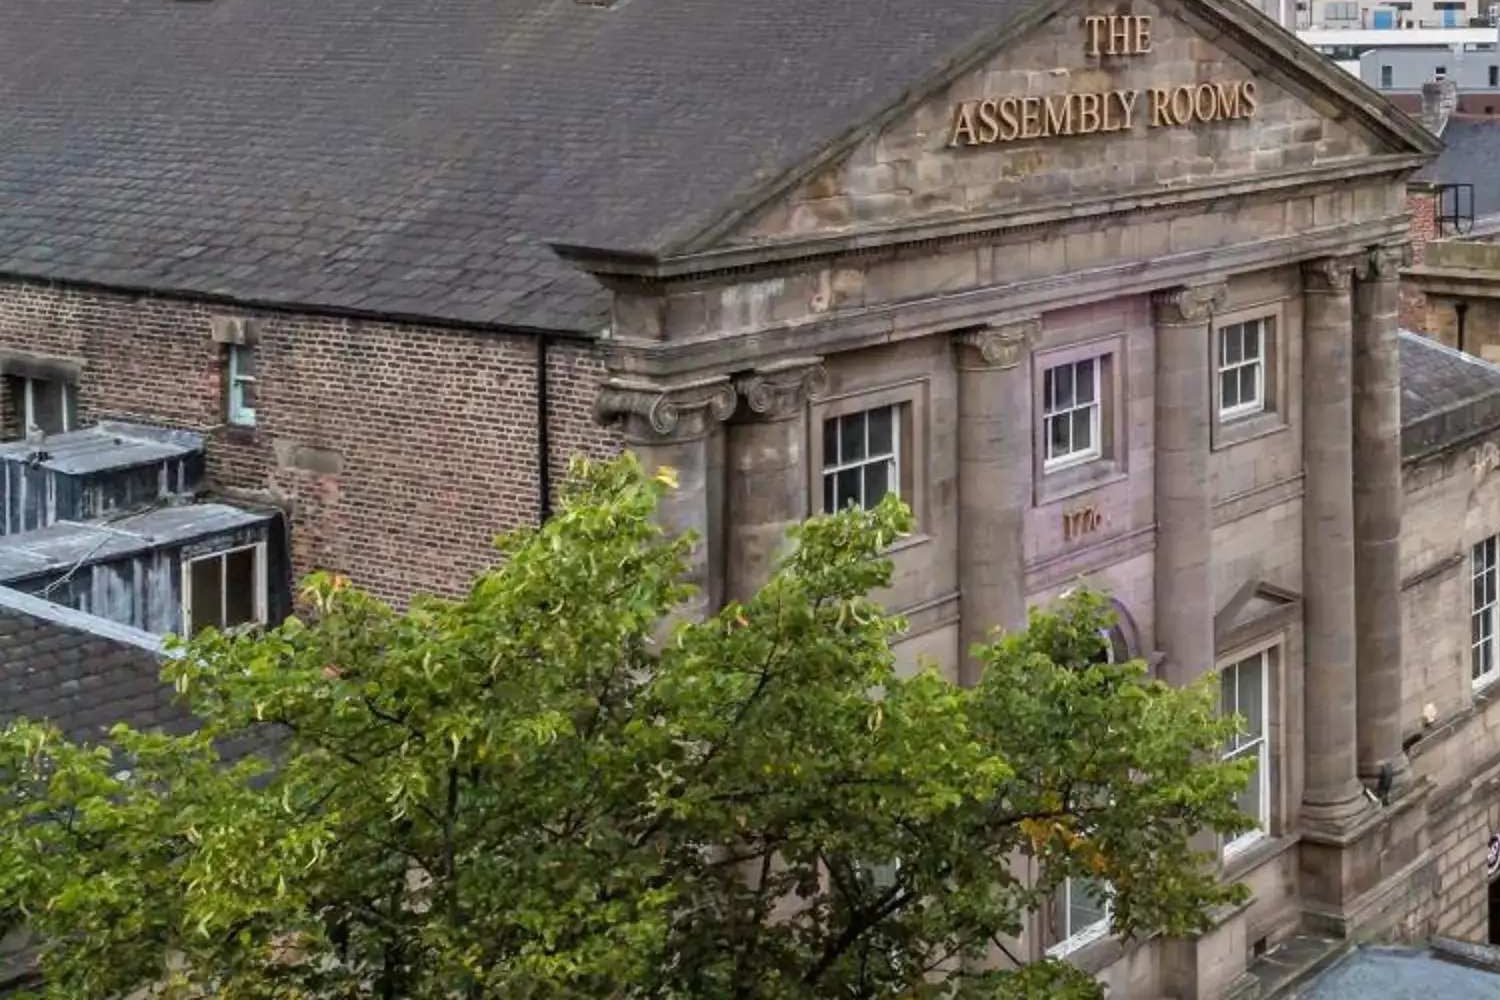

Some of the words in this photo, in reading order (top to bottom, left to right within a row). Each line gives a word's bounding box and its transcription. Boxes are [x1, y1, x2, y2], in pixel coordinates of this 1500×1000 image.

[1085, 15, 1151, 55] THE
[950, 89, 1137, 147] ASSEMBLY
[1150, 81, 1257, 127] ROOMS
